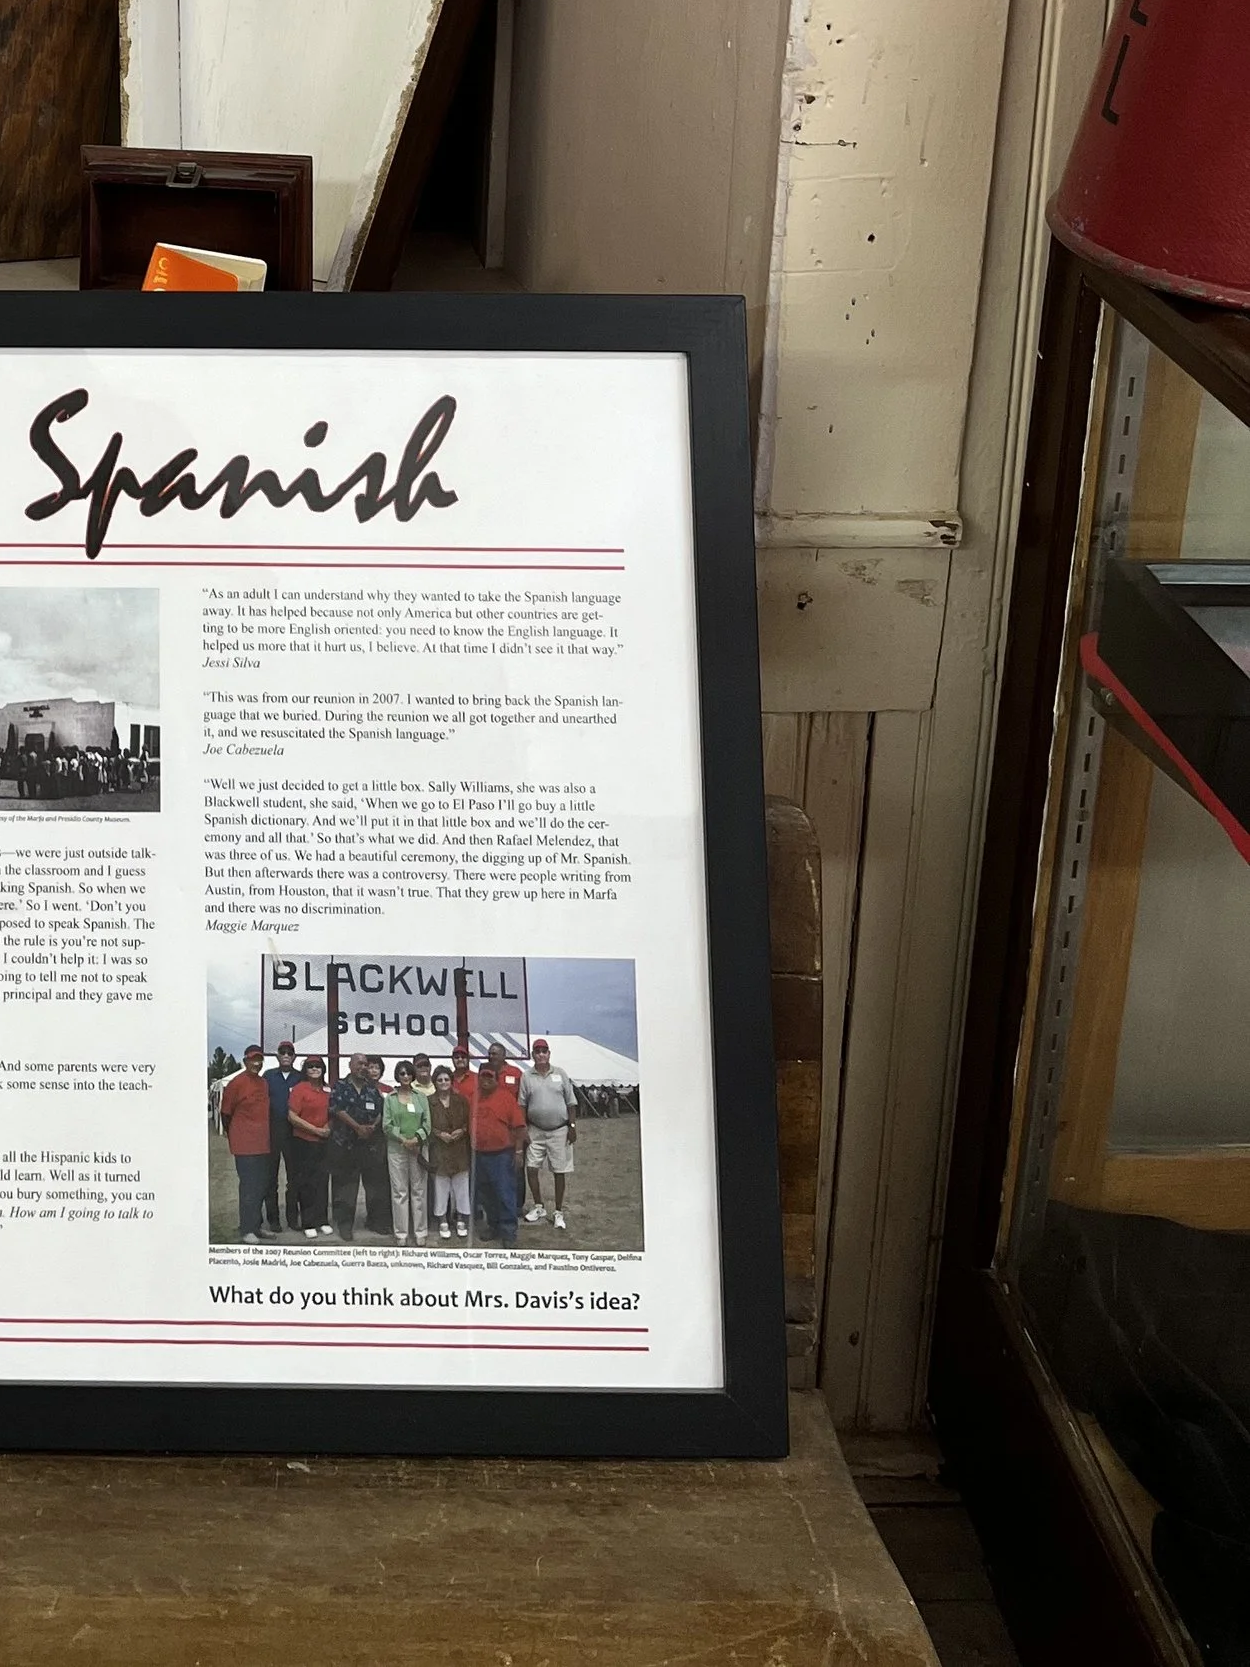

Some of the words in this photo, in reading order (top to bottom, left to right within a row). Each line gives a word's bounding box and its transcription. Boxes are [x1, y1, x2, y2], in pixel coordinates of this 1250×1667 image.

[25, 388, 459, 560] Spanish
[201, 656, 230, 668] Jessi
[232, 656, 260, 668] Silva
[202, 743, 223, 755] Joe
[226, 743, 284, 756] Cabezuela
[205, 919, 247, 934] Maggie
[250, 919, 300, 934] Marquez
[334, 1011, 470, 1037] SCHOO
[208, 1246, 241, 1255] Members
[252, 1247, 264, 1255] the
[265, 1249, 282, 1257] 2007
[283, 1248, 312, 1256] Reunion
[313, 1248, 352, 1256] Committee
[208, 1285, 264, 1305] What
[269, 1285, 294, 1305] do
[300, 1291, 336, 1310] you
[342, 1286, 394, 1306] think
[400, 1287, 459, 1308] about
[464, 1290, 509, 1308] Mrs.
[590, 1291, 640, 1310] idea?
